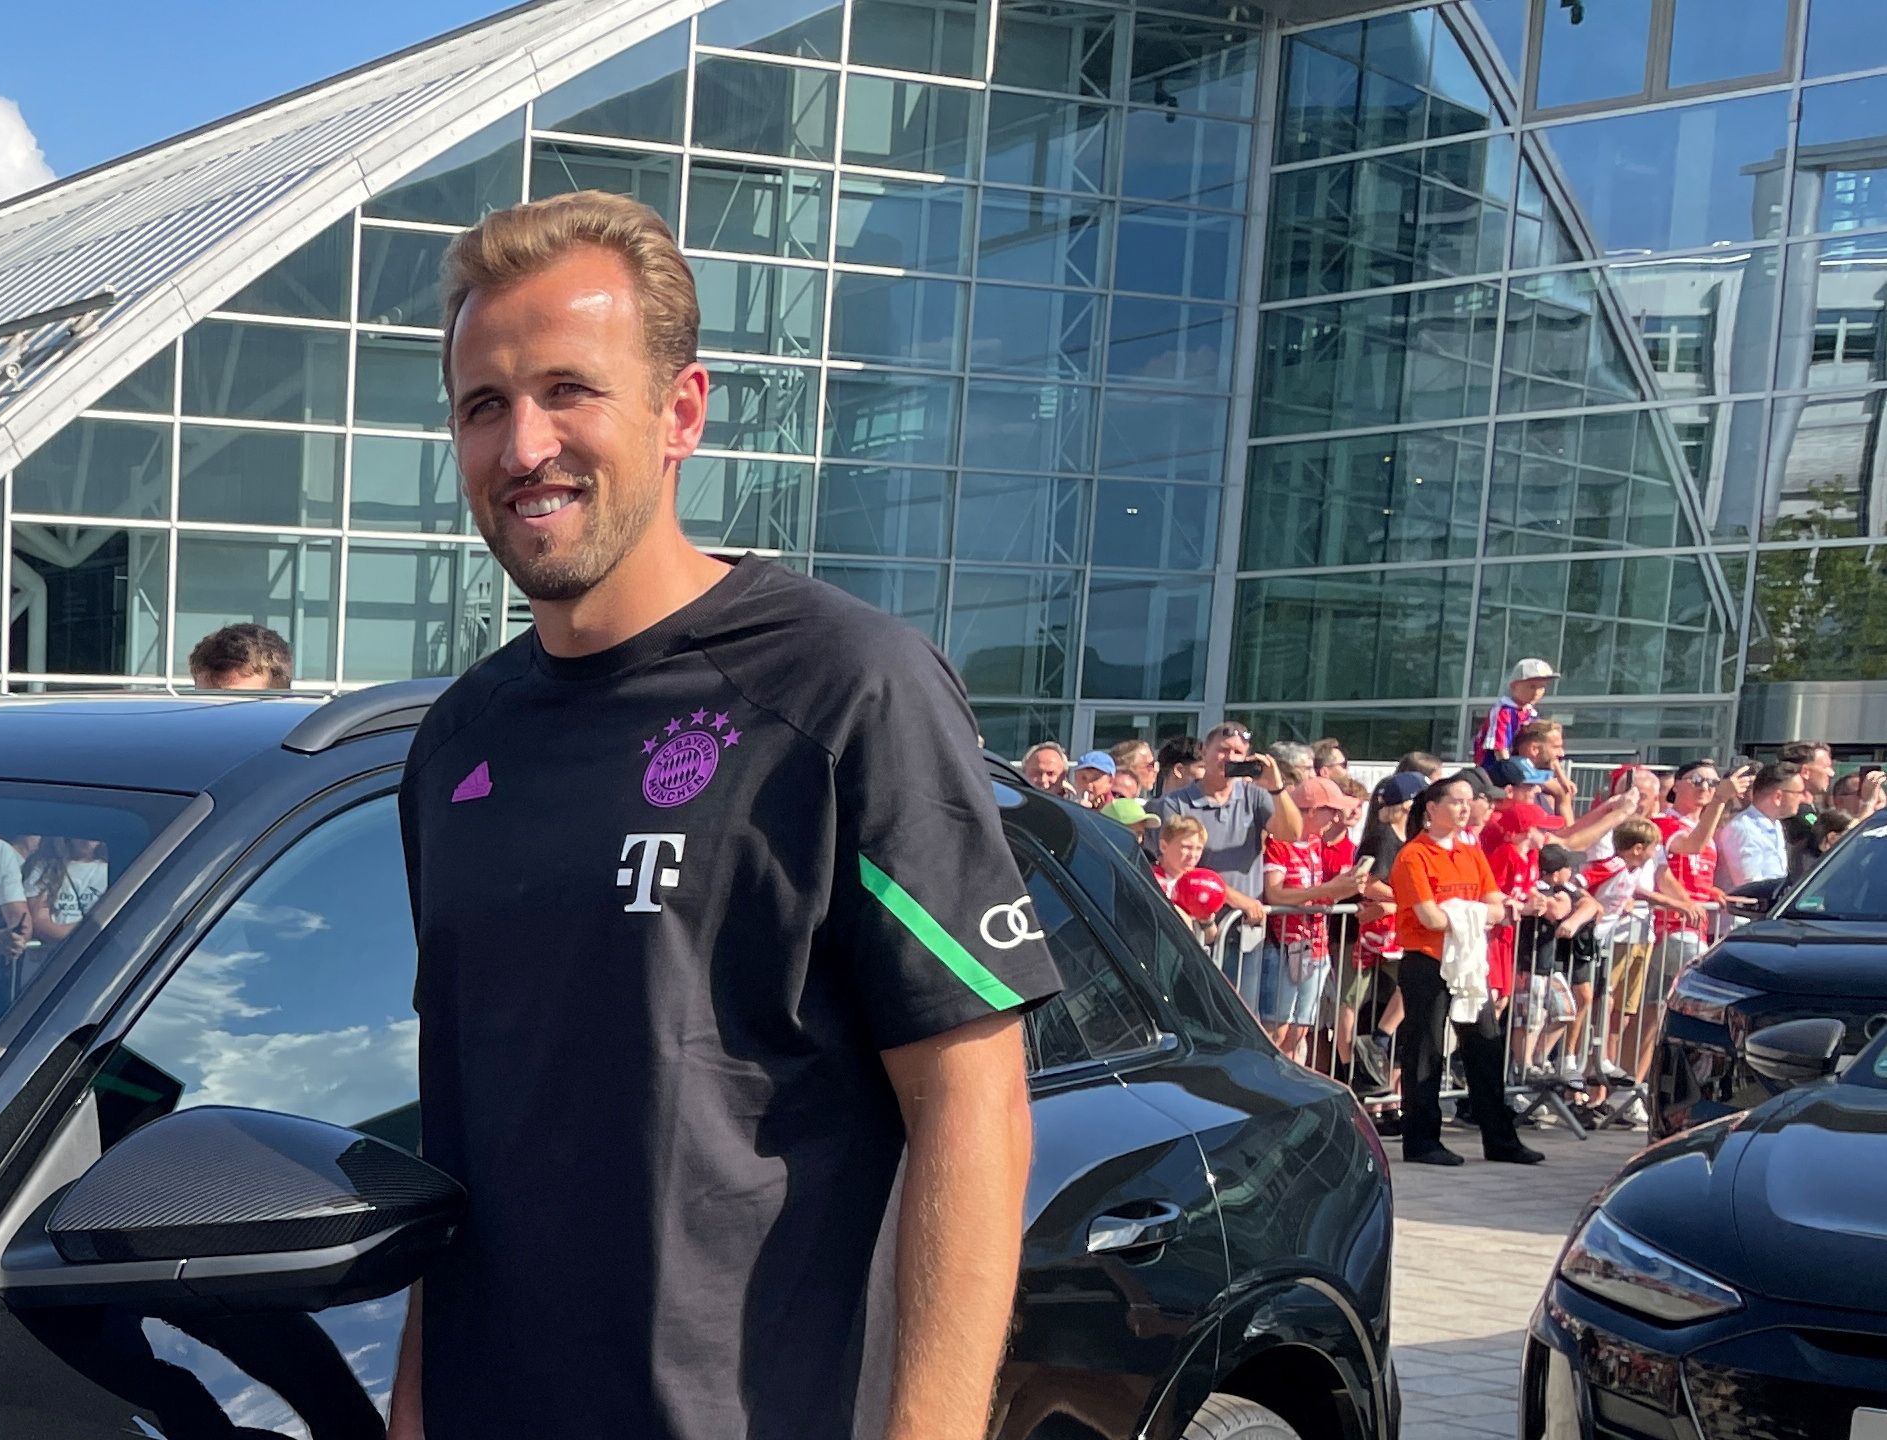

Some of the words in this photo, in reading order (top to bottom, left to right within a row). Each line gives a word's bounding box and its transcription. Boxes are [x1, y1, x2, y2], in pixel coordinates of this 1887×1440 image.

[656, 748, 672, 766] FC
[675, 737, 713, 762] BAYERN
[616, 833, 687, 913] T
